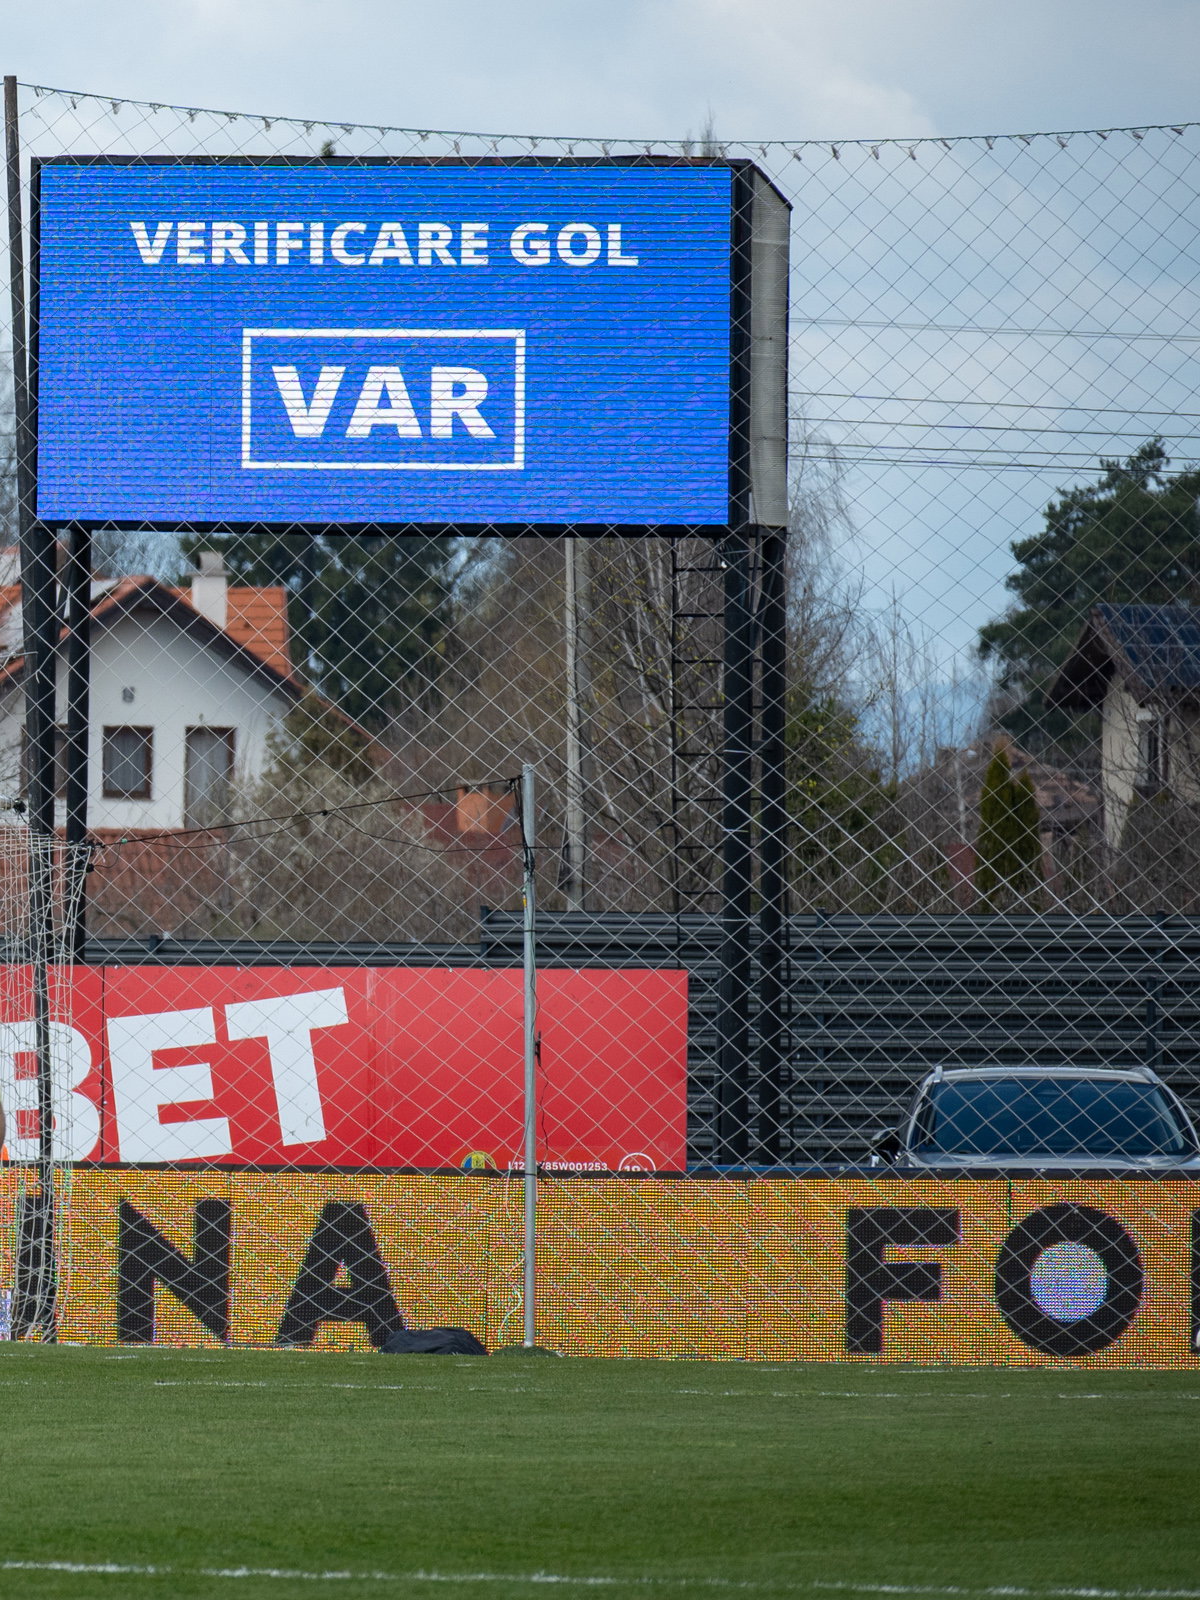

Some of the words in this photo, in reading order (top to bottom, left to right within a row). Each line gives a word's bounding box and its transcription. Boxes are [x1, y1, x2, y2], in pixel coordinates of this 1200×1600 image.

[129, 221, 489, 266] VERIFICARE
[509, 223, 639, 267] GOL
[271, 365, 497, 438] VAR
